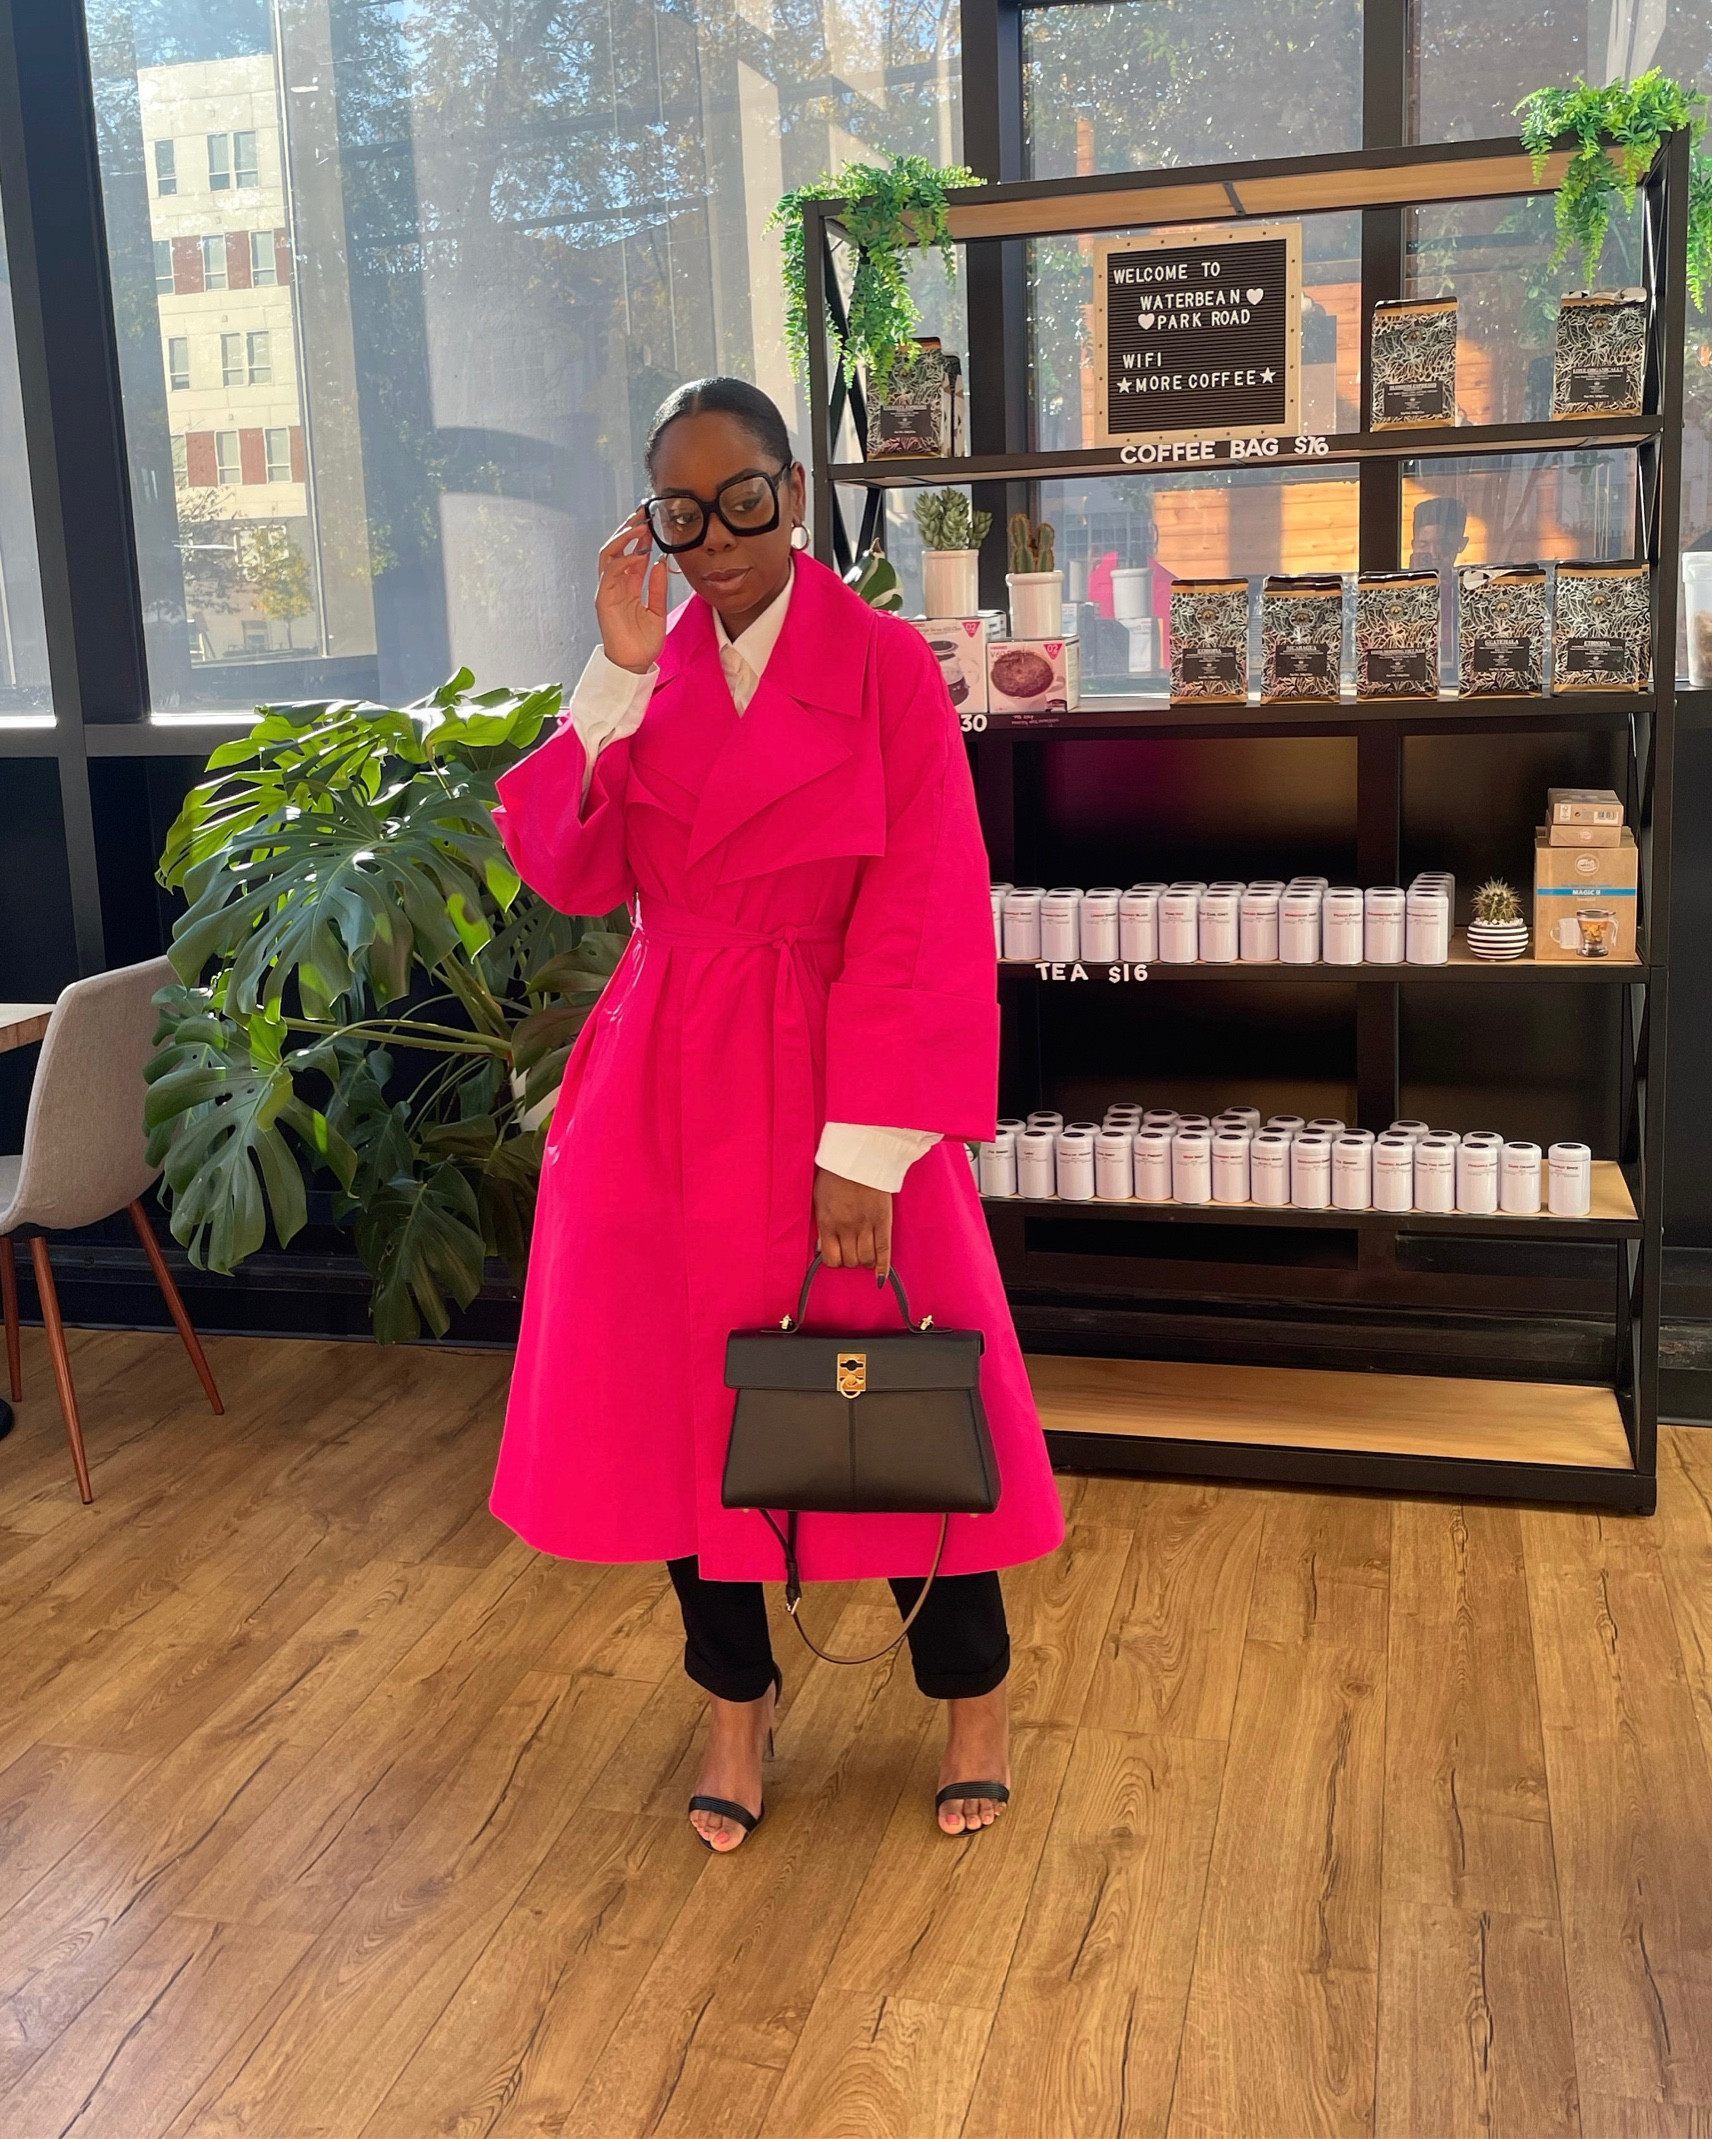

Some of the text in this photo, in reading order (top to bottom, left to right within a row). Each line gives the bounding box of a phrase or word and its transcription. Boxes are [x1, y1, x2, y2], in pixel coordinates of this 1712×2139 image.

[1113, 262, 1221, 284] WELCOME TO
[1140, 289, 1240, 311] WATERBEAN
[1157, 309, 1250, 330] PARK ROAD
[1122, 352, 1162, 369] WIFI
[1135, 370, 1256, 393] MORE COFFEE
[1120, 435, 1329, 464] COFFEE BAG $16
[1034, 962, 1149, 984] TEA $16
